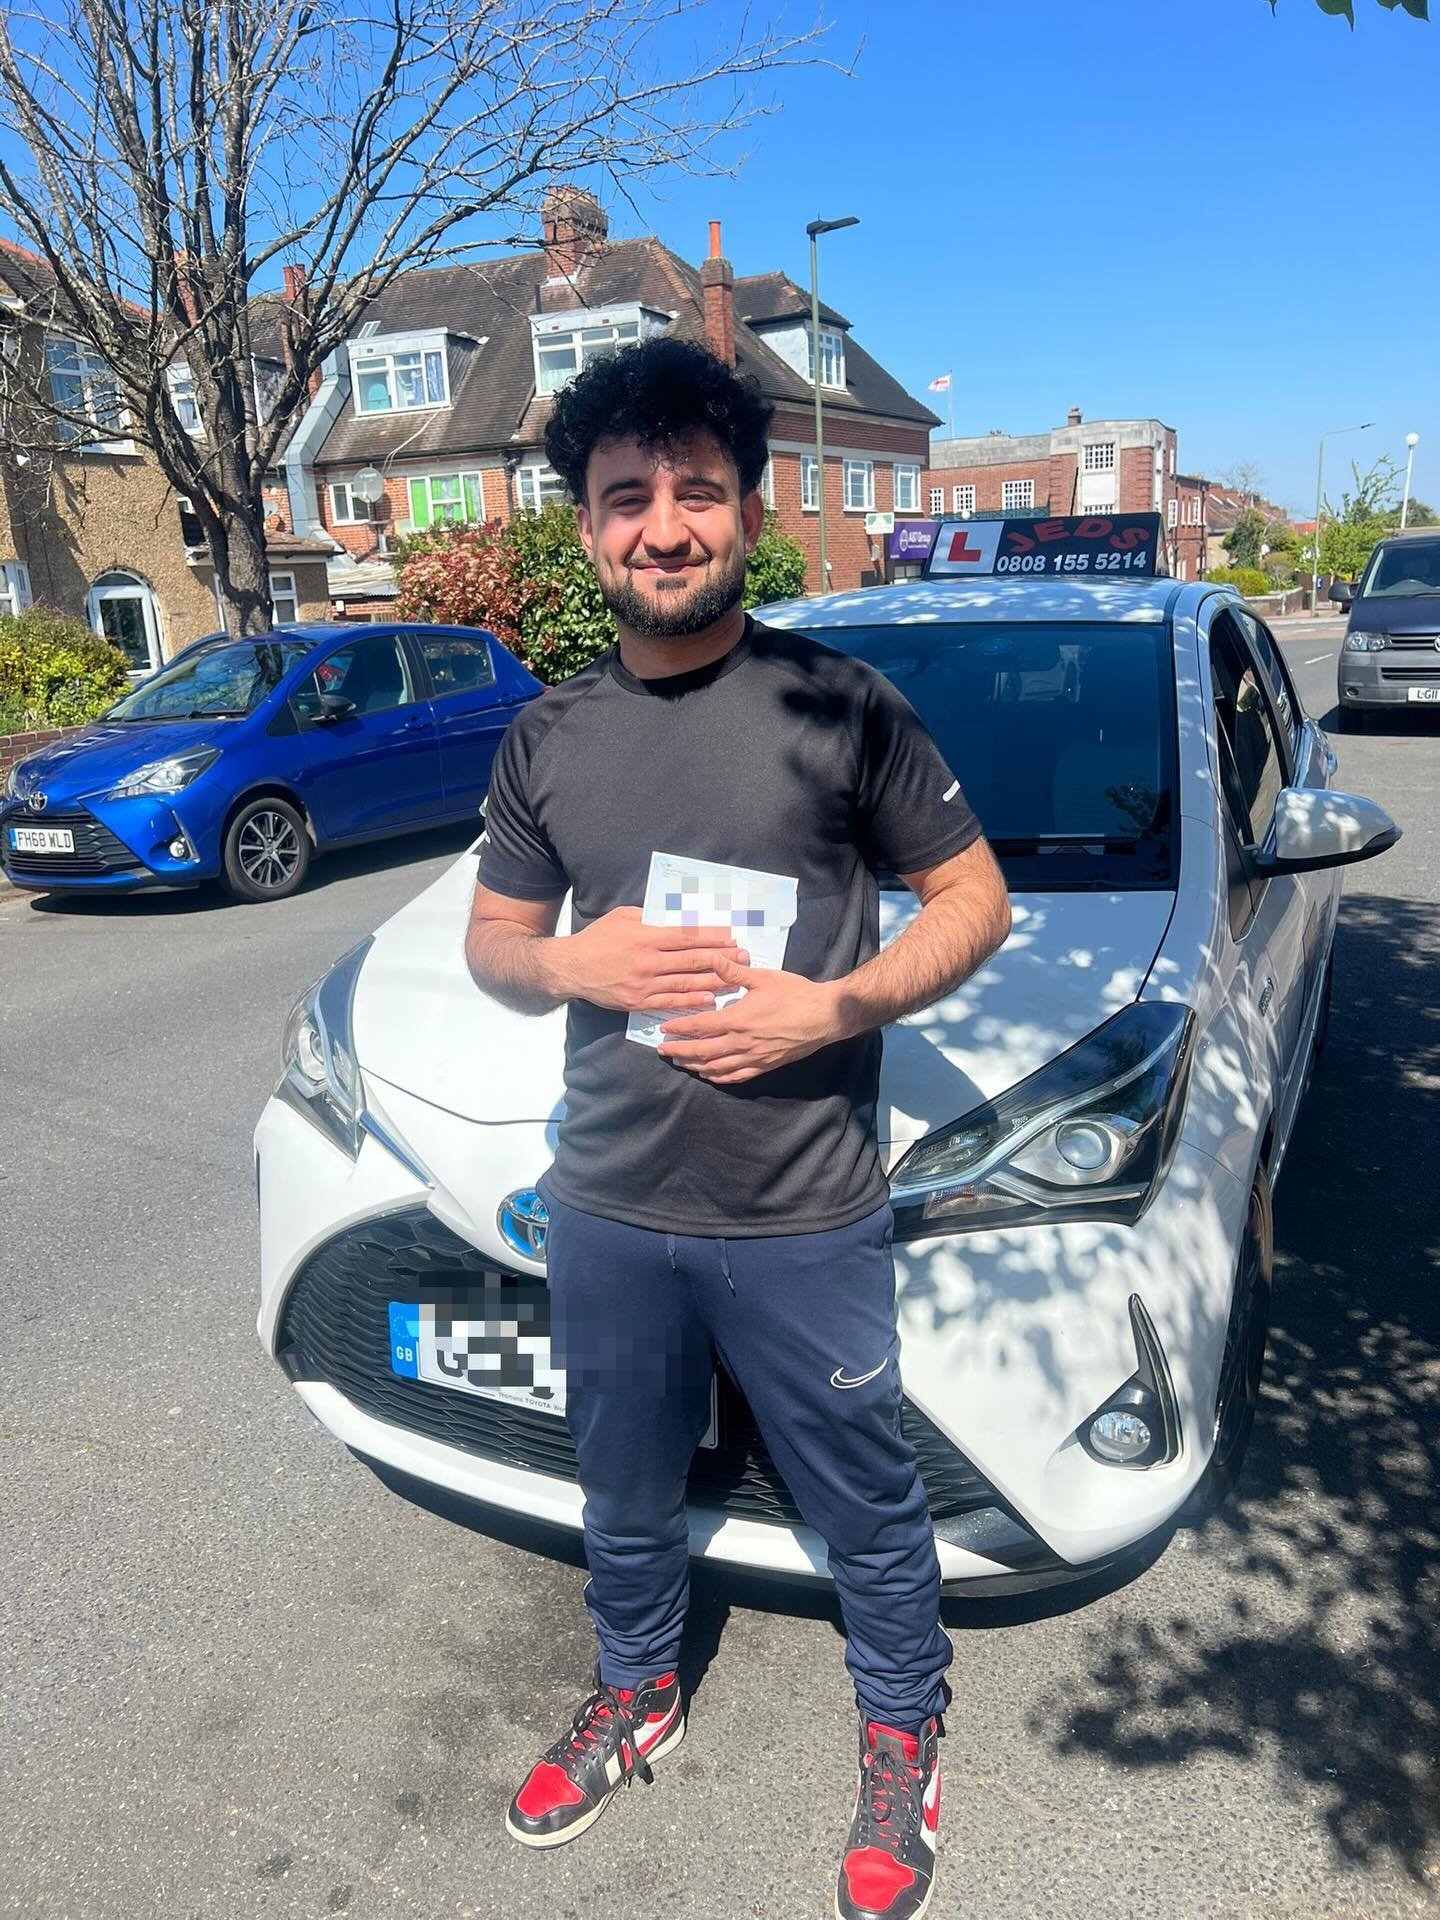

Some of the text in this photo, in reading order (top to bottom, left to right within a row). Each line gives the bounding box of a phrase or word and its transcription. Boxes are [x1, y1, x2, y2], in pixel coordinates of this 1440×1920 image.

[1007, 517, 1150, 552] JEDS
[947, 531, 982, 562] L
[997, 551, 1146, 572] 0808 155 5214
[18, 831, 71, 849] FH68 WLD
[396, 1343, 413, 1362] GB
[525, 1398, 551, 1409] TOYOTA
